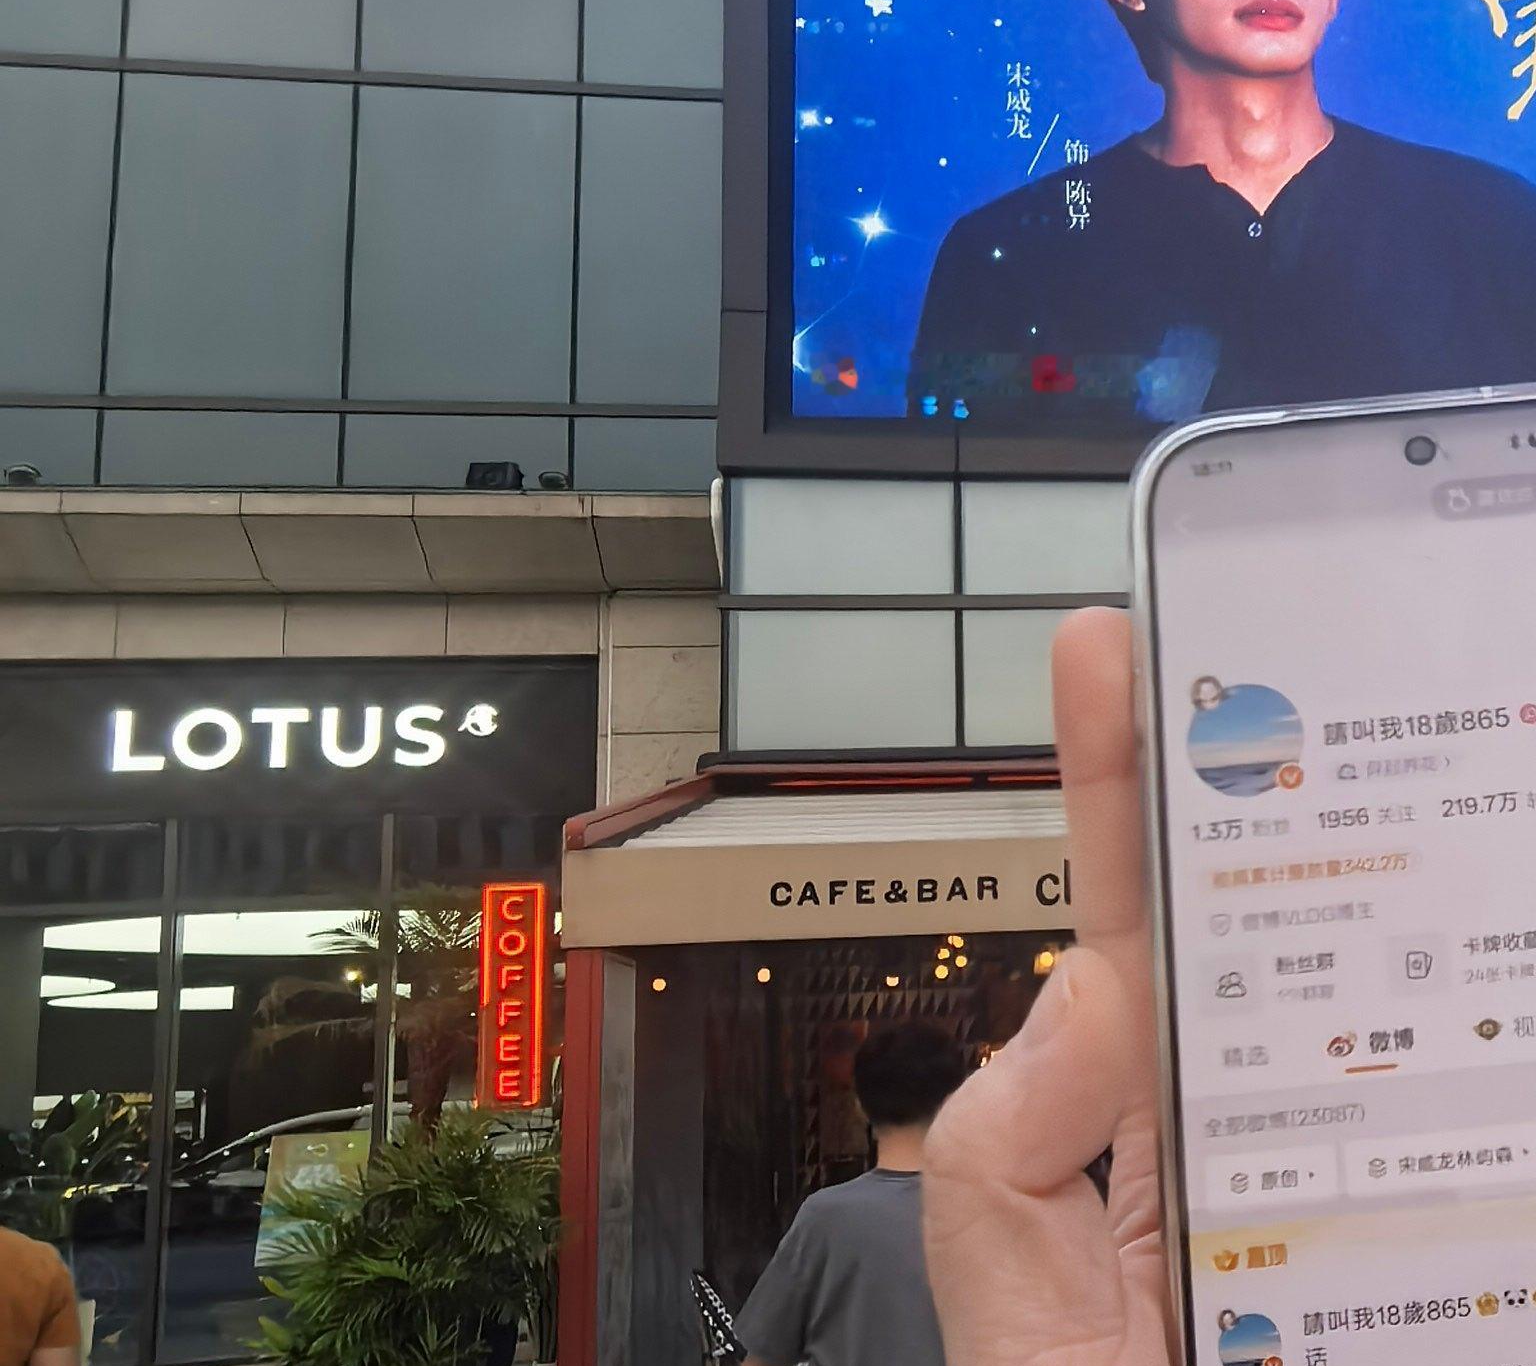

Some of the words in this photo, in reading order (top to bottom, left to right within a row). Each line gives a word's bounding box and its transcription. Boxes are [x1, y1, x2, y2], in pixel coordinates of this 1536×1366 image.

[1006, 62, 1032, 139] 宋威龙
[111, 704, 446, 773] LOTUS
[1318, 807, 1370, 829] 1956
[1441, 791, 1518, 818] 219.7万
[769, 875, 1000, 907] CAFE&BAR
[497, 895, 526, 1100] COFFEE
